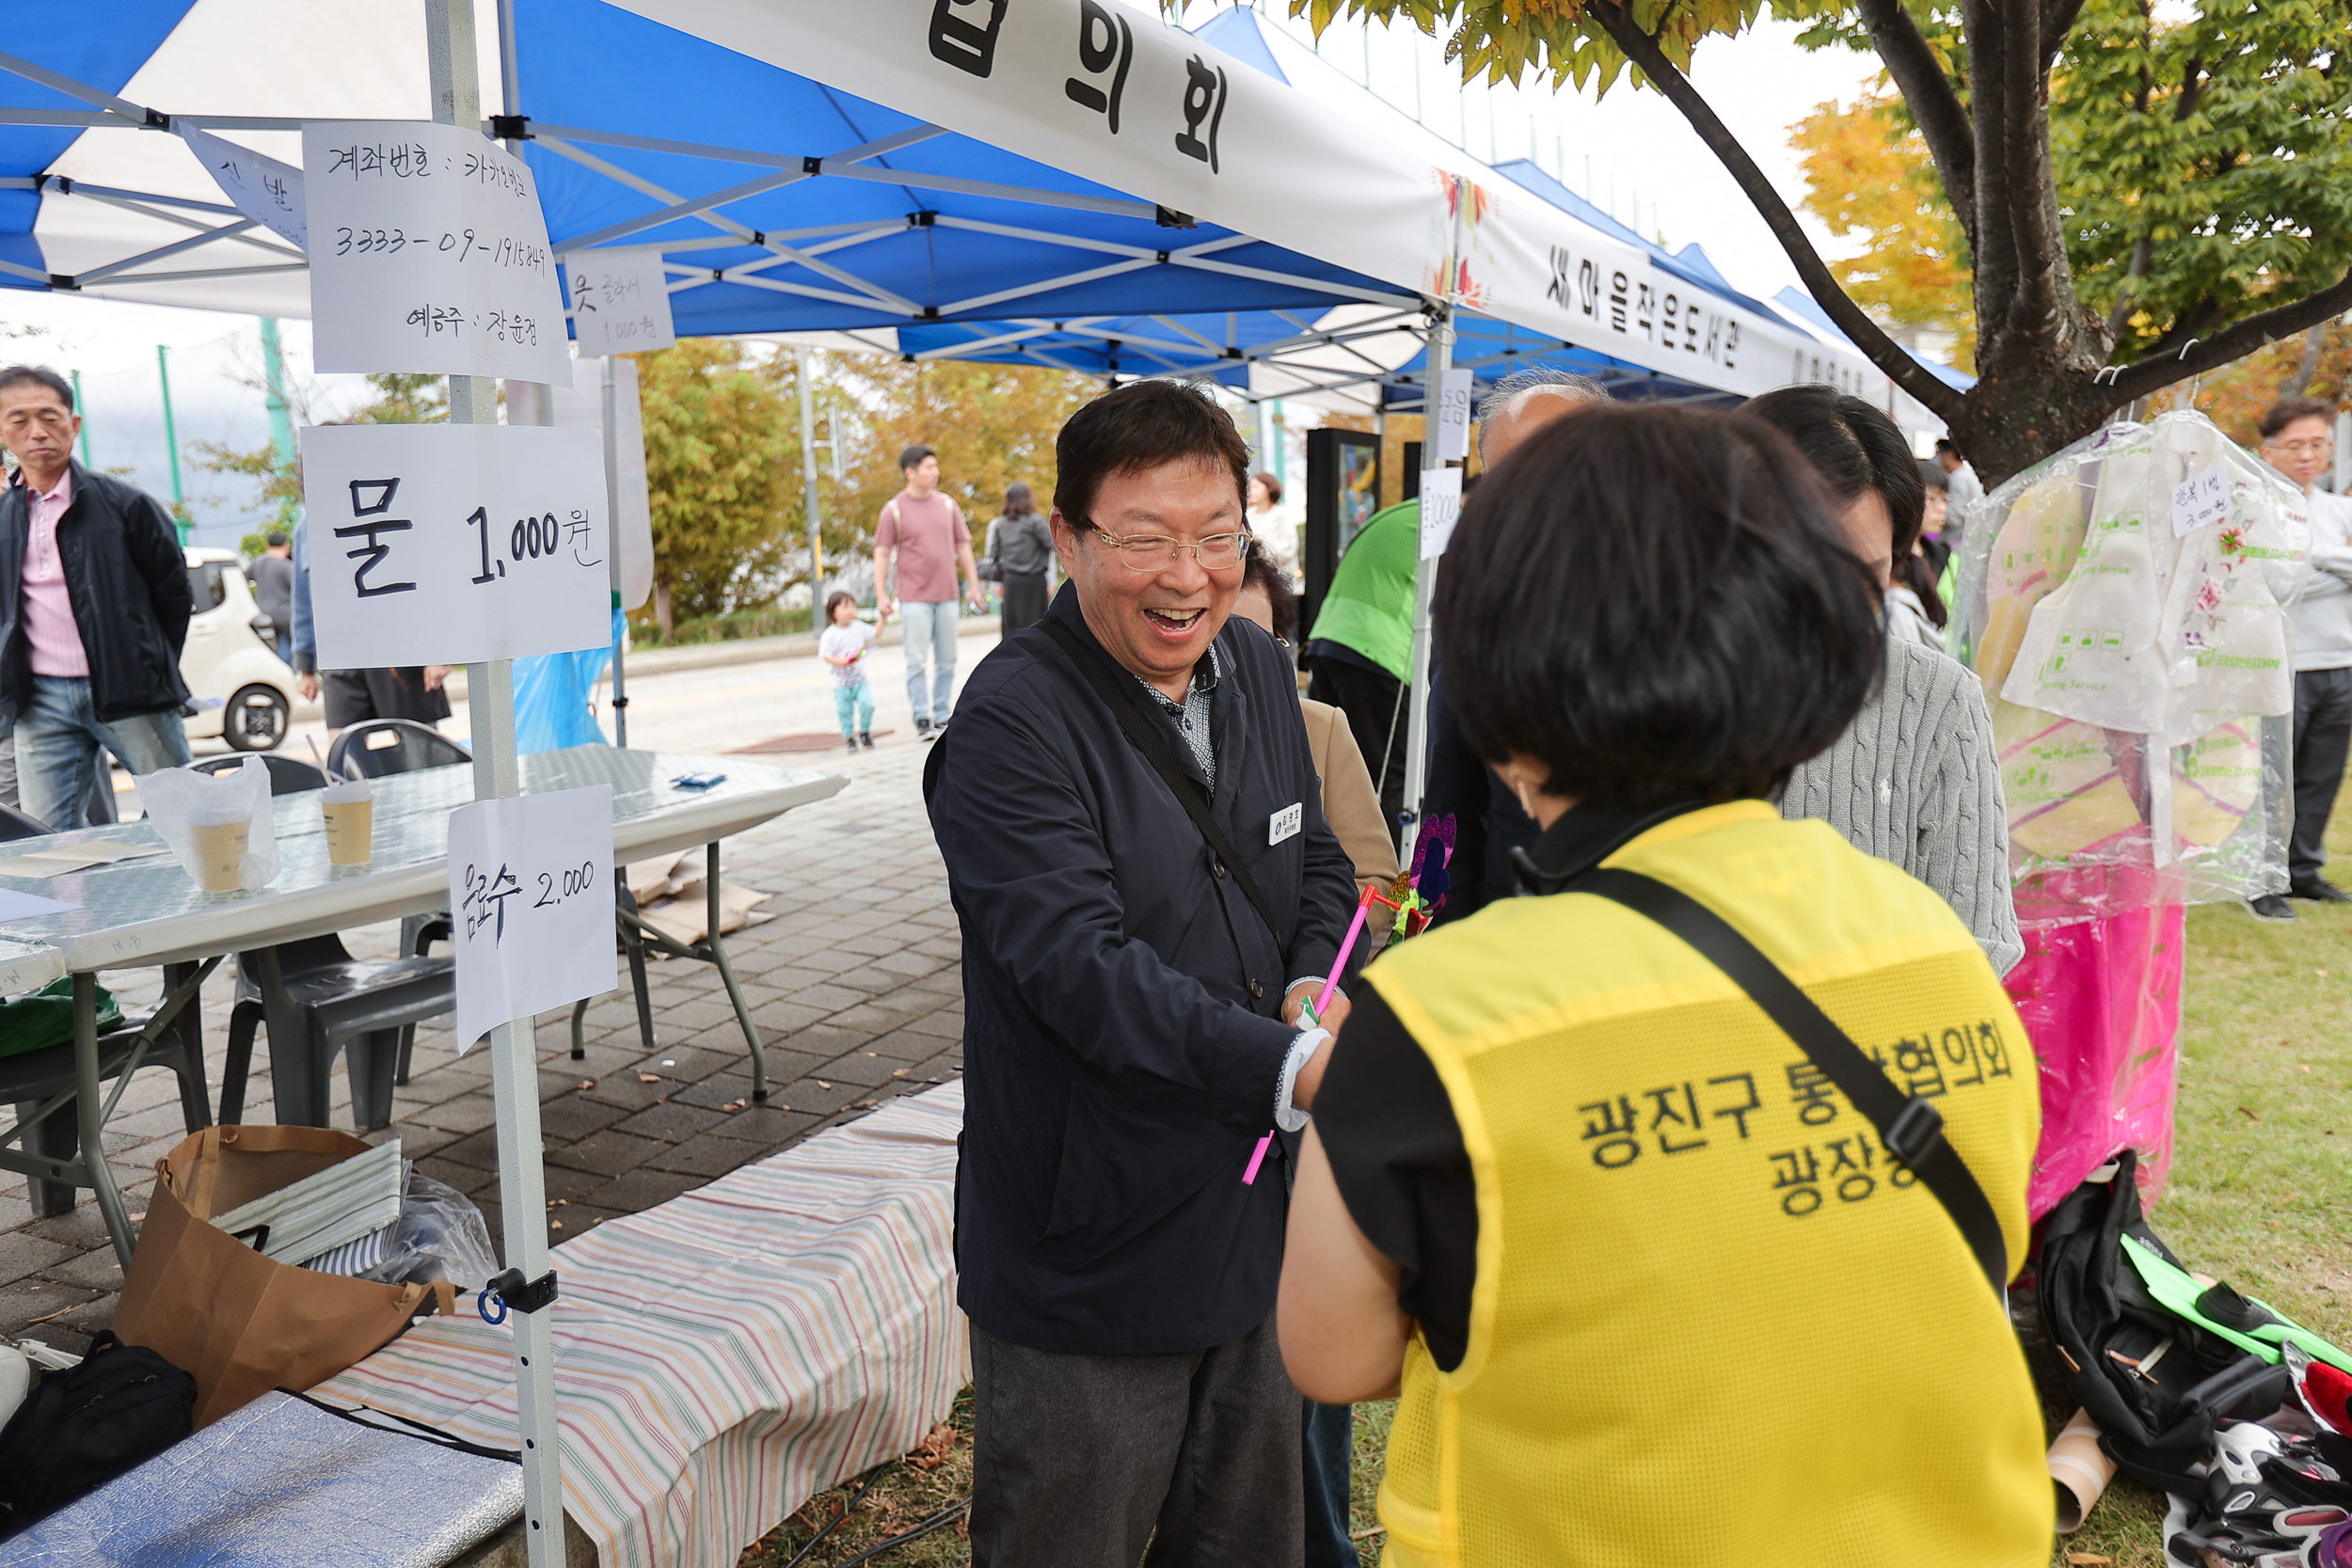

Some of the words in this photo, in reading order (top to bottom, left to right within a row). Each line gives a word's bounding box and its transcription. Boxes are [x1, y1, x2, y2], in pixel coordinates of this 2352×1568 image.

[328, 142, 432, 182] 계좌번호
[406, 303, 465, 339] 예금주
[486, 309, 537, 347] 장윤정
[333, 476, 418, 598] 물
[467, 505, 603, 585] 1,000원
[462, 862, 523, 950] 음료수
[1578, 1072, 1762, 1170] 광진구
[1785, 1018, 2013, 1128] 통협의회
